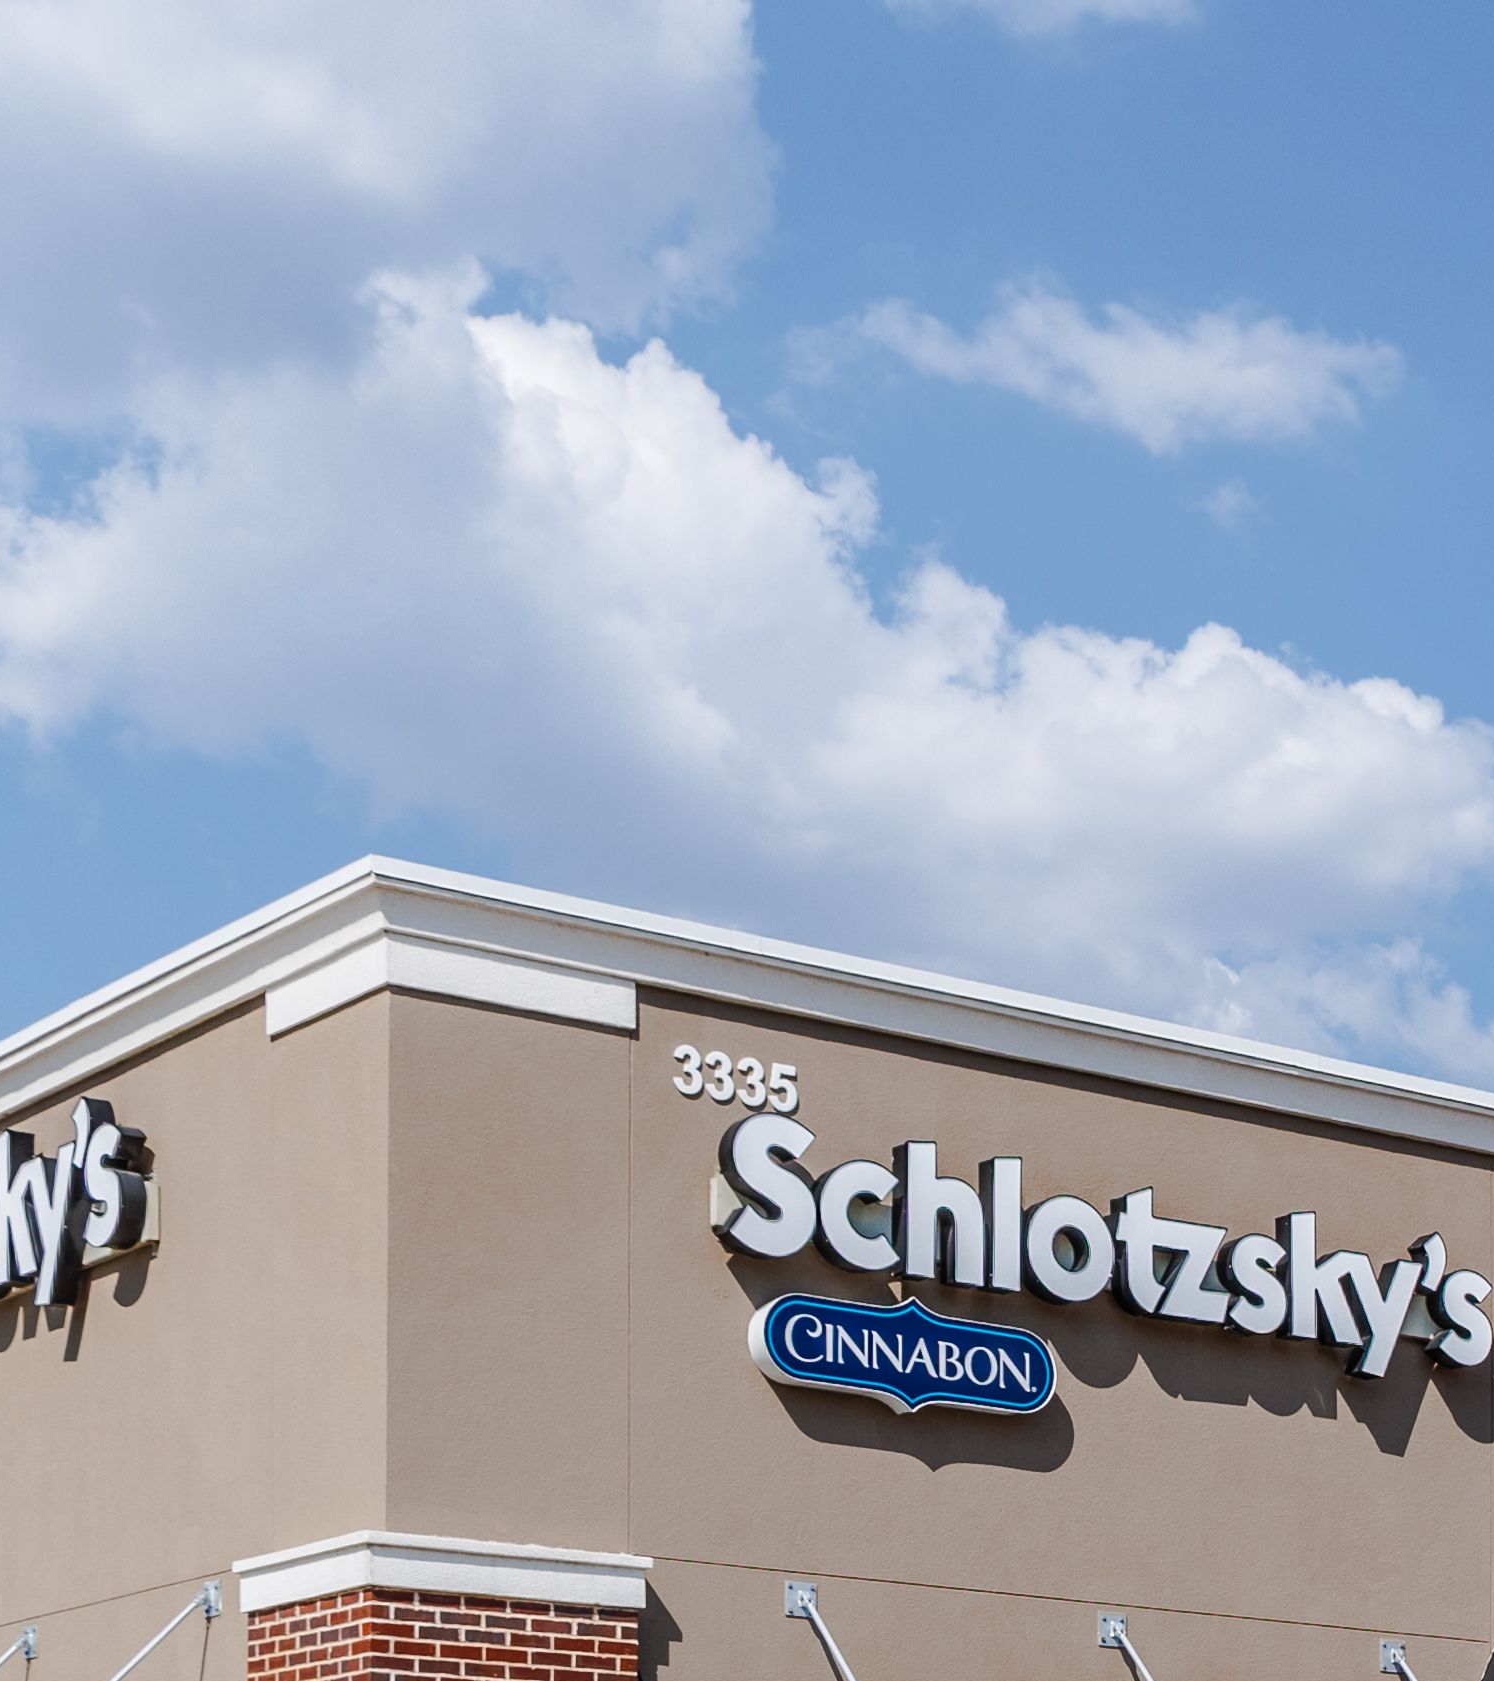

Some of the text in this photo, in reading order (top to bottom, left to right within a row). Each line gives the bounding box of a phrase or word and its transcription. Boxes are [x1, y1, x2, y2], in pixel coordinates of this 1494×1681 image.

[672, 1044, 799, 1112] 3335
[726, 1112, 1494, 1380] Schlotzsky's
[785, 1313, 1034, 1393] CINNABON
